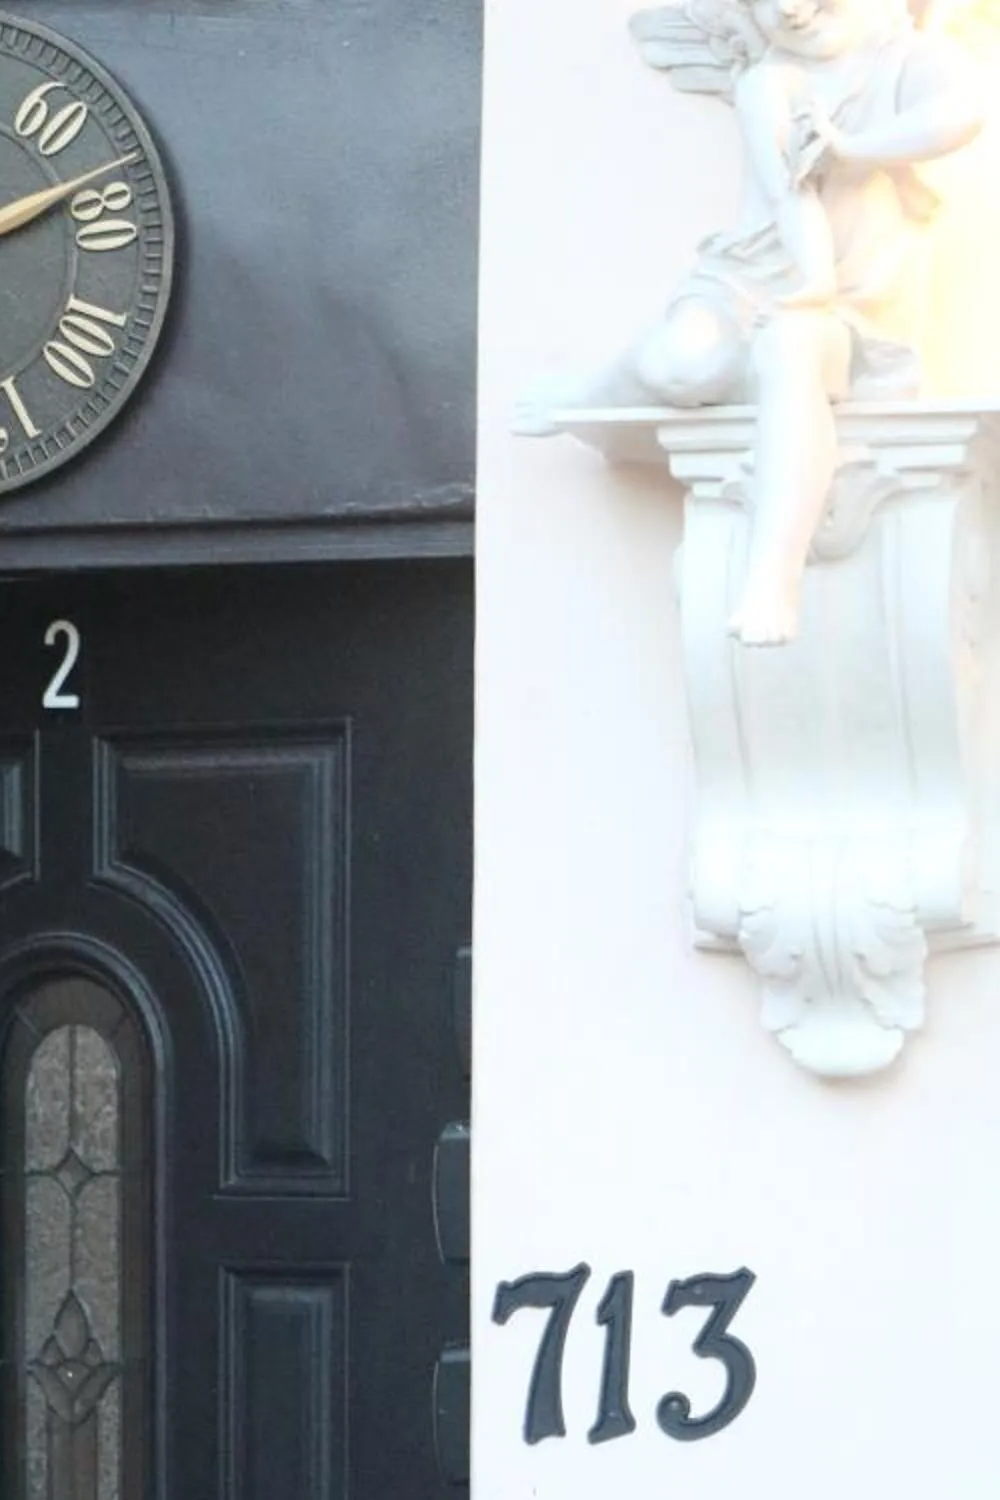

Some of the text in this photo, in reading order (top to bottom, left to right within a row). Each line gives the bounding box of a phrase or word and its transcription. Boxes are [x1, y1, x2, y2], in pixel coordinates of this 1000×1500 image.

[14, 80, 87, 156] 60
[71, 181, 138, 251] 80
[43, 294, 129, 389] 100
[42, 619, 81, 709] 2
[490, 1261, 758, 1446] 713
